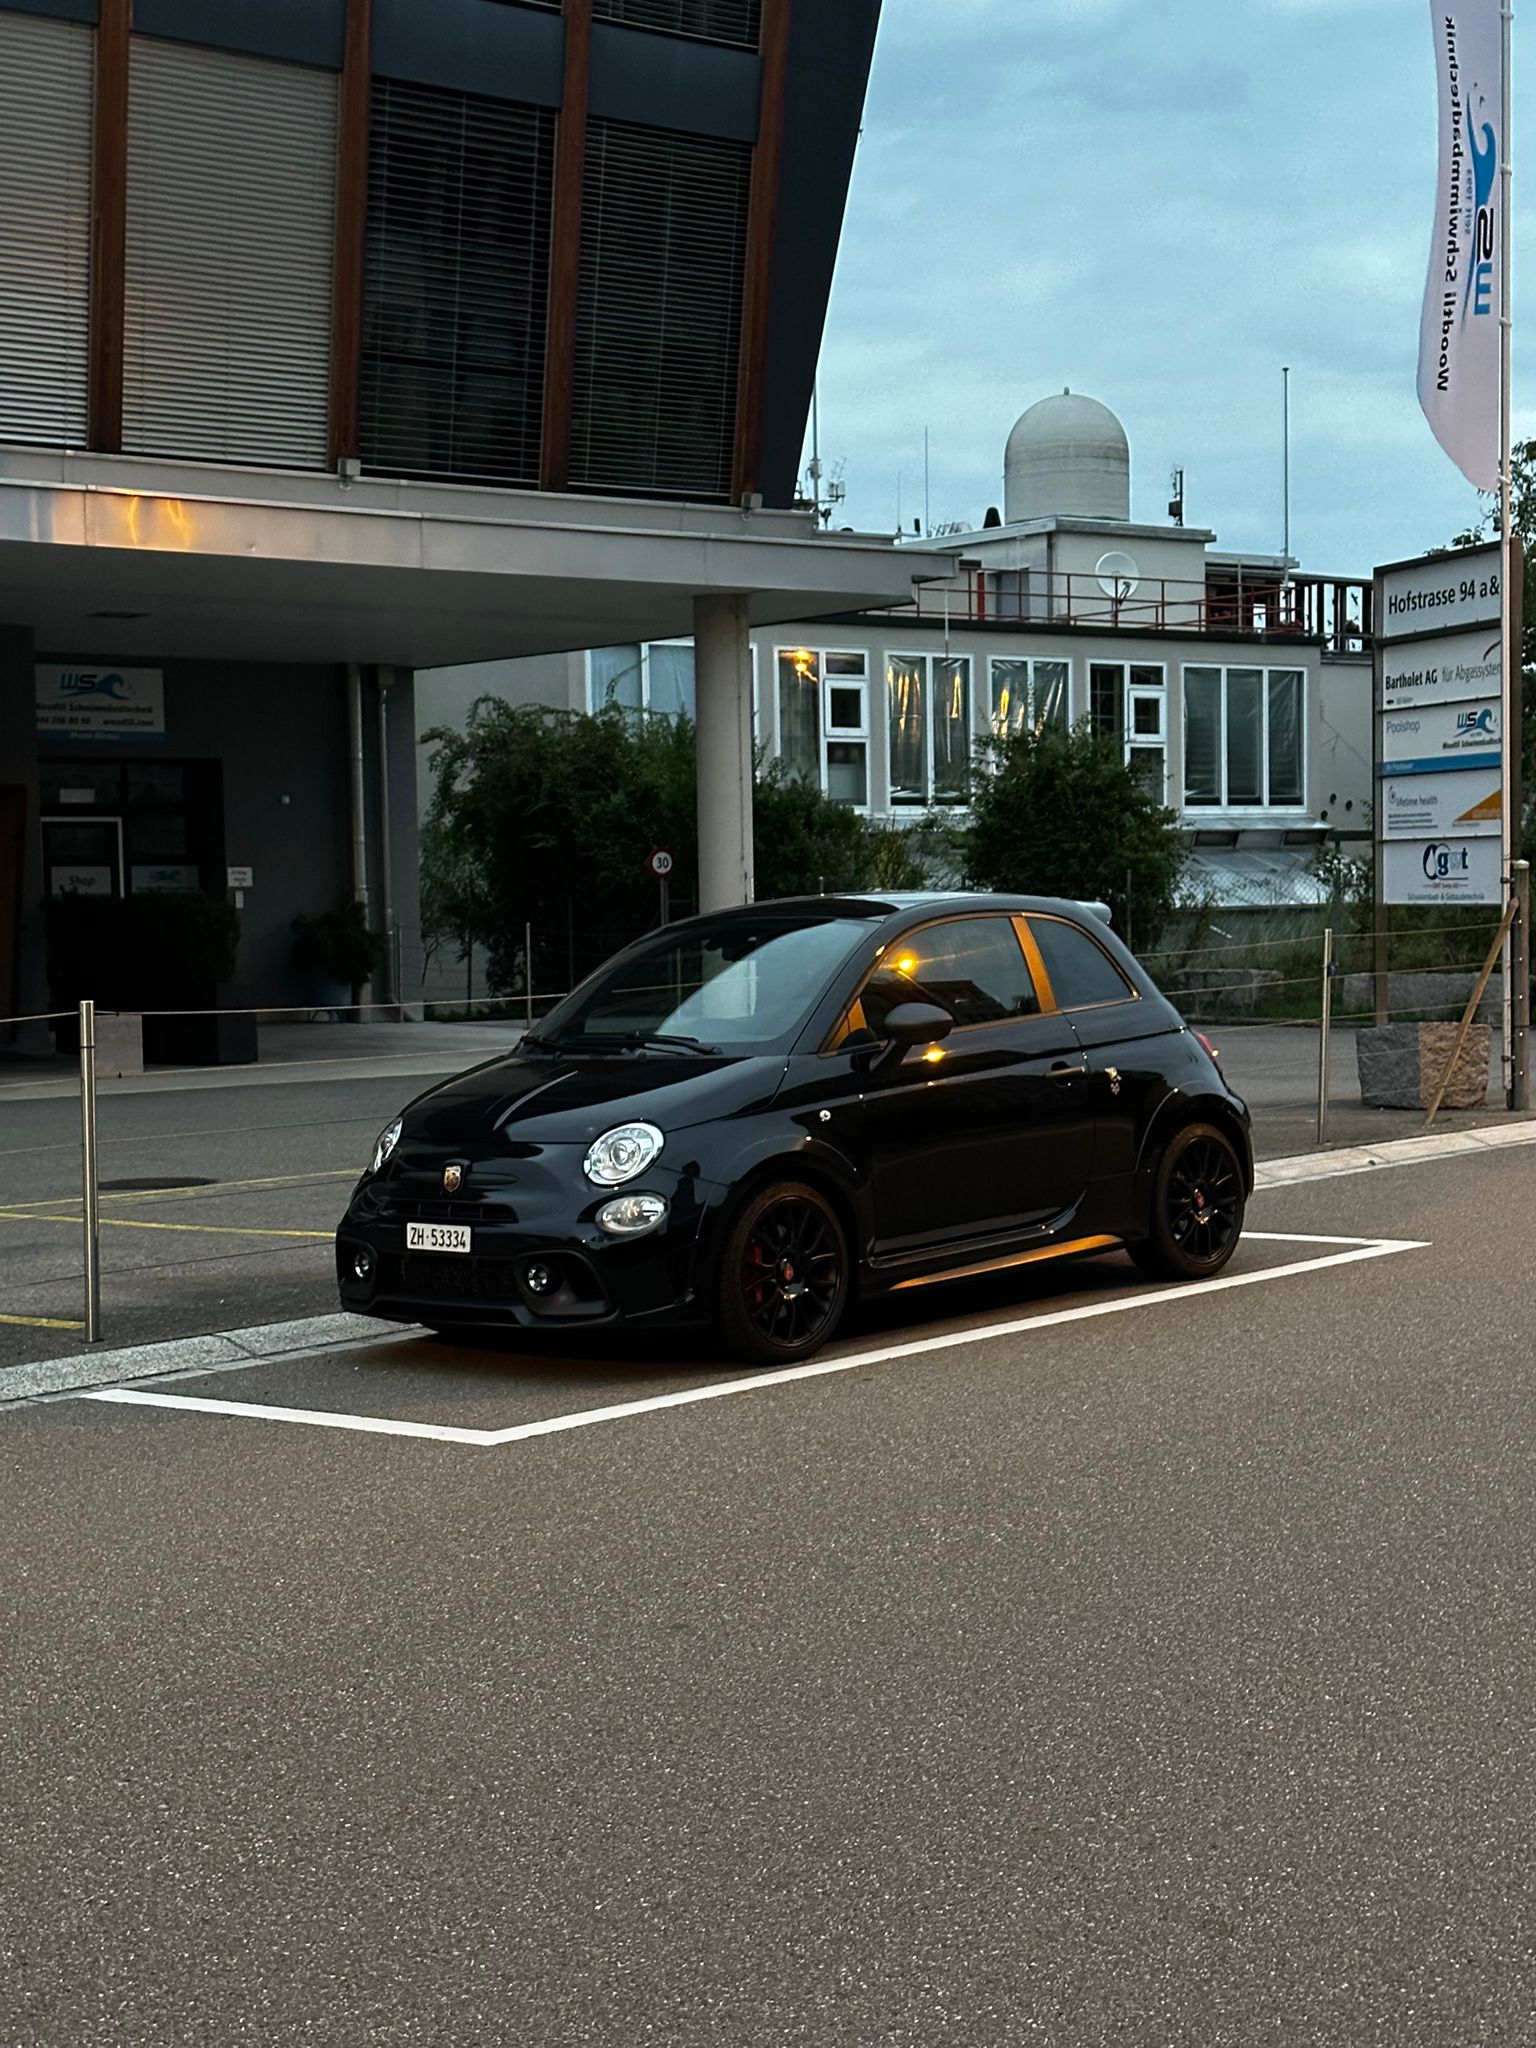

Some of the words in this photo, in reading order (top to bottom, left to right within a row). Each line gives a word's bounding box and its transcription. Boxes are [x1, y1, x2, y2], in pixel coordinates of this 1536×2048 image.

[1388, 587, 1456, 615] Hofstrasse
[1459, 579, 1476, 602] 94
[1385, 671, 1424, 690] Bartholet
[1424, 668, 1438, 684] AG
[1386, 719, 1421, 734] Poolshop
[656, 856, 669, 869] 30
[68, 874, 96, 888] Shop
